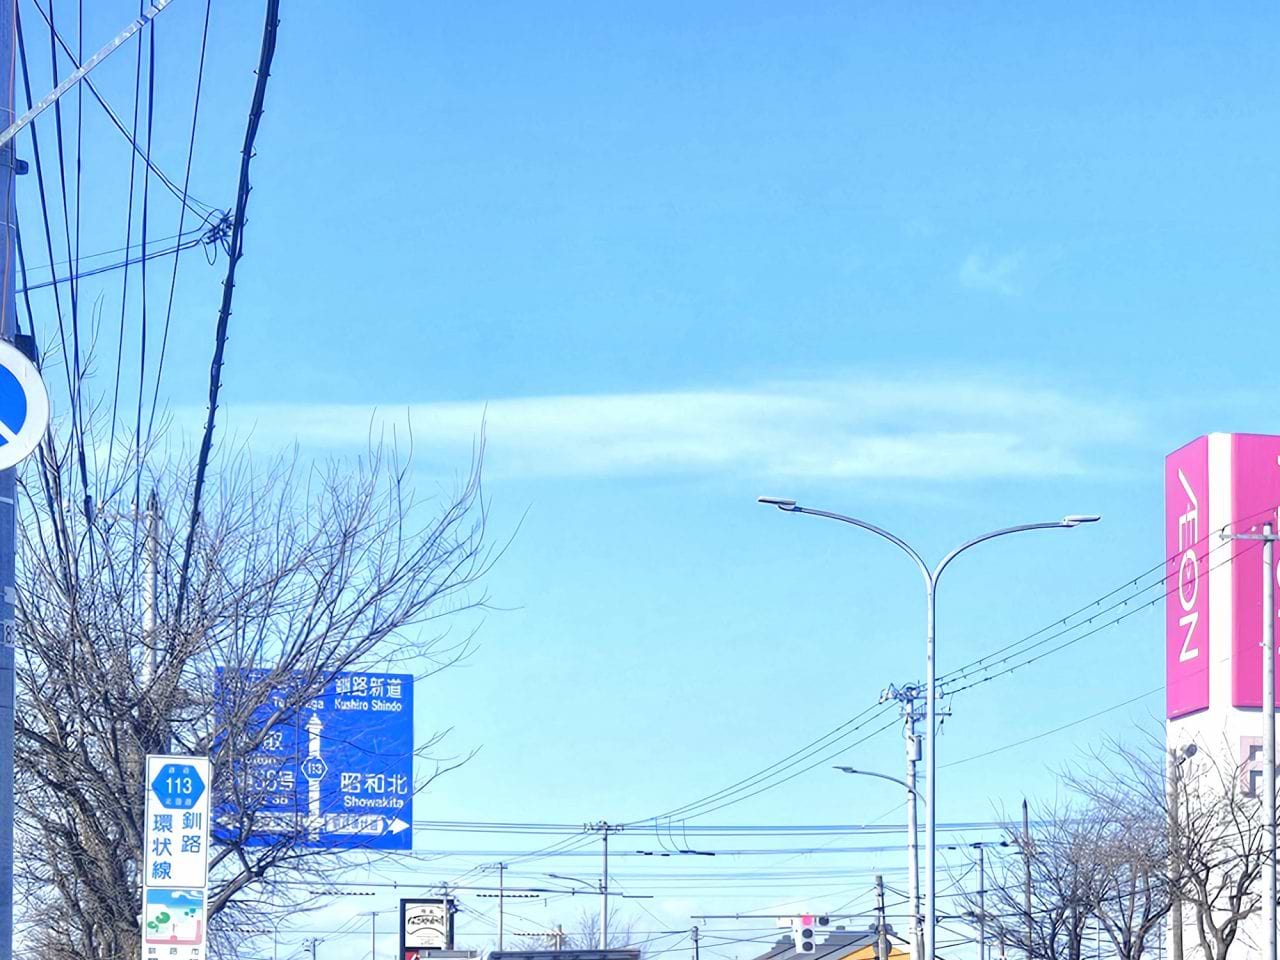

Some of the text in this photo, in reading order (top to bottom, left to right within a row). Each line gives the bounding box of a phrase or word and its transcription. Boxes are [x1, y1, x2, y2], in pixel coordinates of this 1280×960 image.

[335, 676, 403, 699] 釧路新道
[334, 698, 369, 712] Kushiro
[371, 699, 402, 713] Shindo
[166, 777, 193, 794] 113
[340, 772, 408, 795] 昭和北
[343, 795, 405, 808] Showakita
[181, 811, 202, 853] 釧路
[152, 813, 173, 879] 環状線
